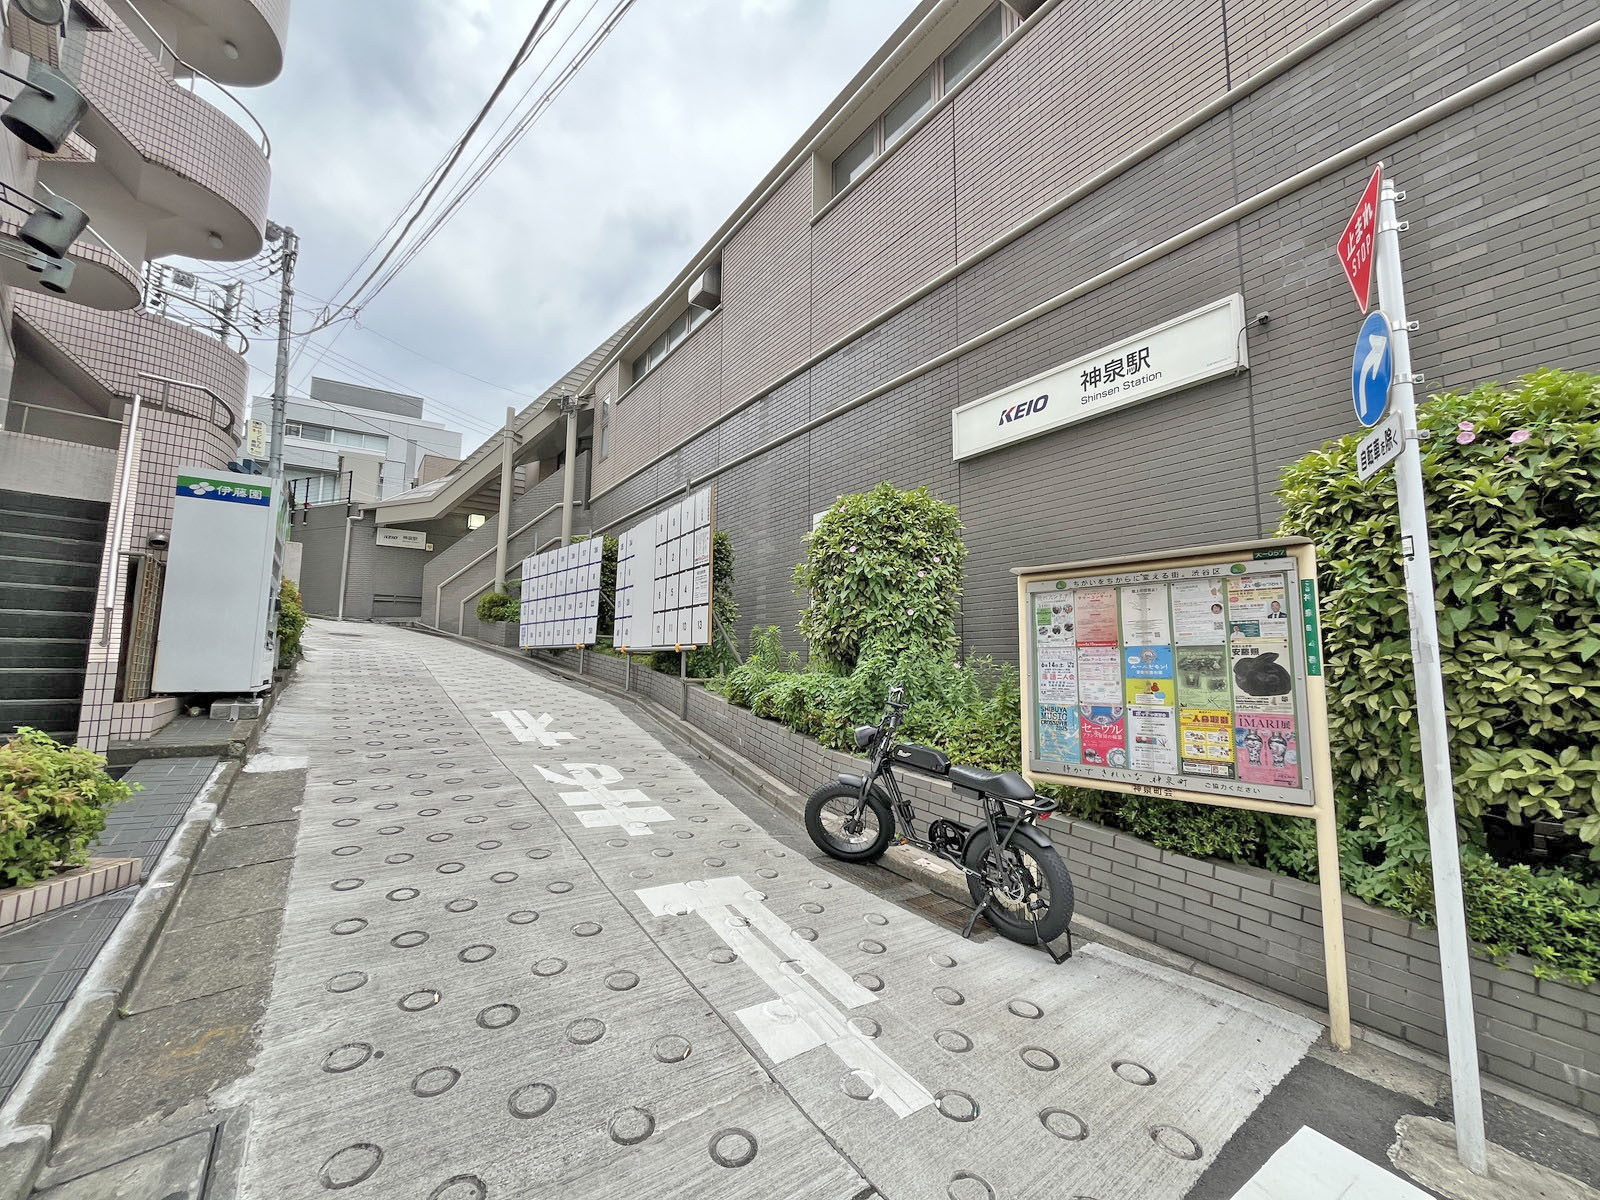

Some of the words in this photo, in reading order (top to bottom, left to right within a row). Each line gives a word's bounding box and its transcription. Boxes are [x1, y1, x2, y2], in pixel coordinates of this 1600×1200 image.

[1346, 202, 1374, 262] 止まれ
[1352, 234, 1371, 277] STOP
[1080, 346, 1151, 392] 神泉駅
[1080, 386, 1120, 405] Shinsen
[1122, 370, 1162, 390] Station
[999, 394, 1049, 426] KEIO
[1360, 427, 1398, 472] 自転車を除く
[216, 485, 263, 500] 伊藤園
[1041, 712, 1068, 720] MUSIC
[1204, 782, 1261, 794] ご協力ください
